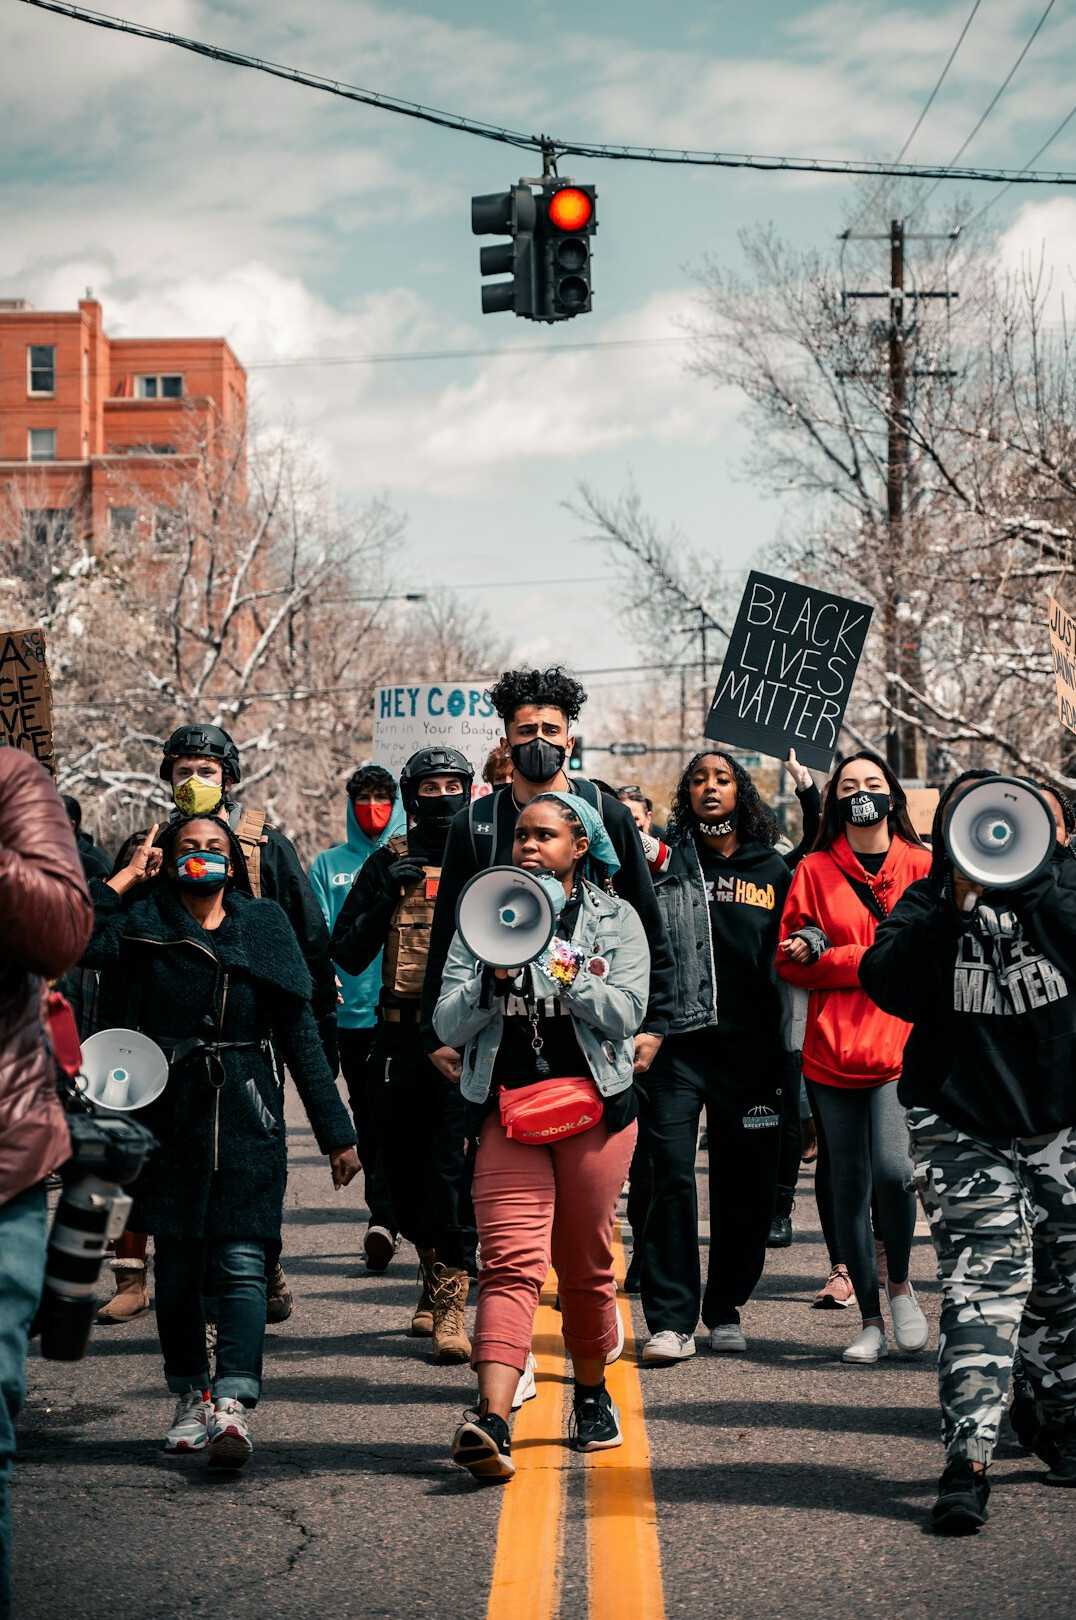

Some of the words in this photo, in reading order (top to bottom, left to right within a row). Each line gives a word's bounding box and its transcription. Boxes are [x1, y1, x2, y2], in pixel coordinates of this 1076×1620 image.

[747, 583, 865, 659] BLACK
[740, 632, 847, 696] LIVES
[0, 674, 41, 707] GE
[380, 688, 419, 718] HEY
[427, 687, 495, 717] COPS
[712, 671, 841, 748] MATTER
[375, 721, 397, 734] Turn
[402, 720, 413, 734] in
[423, 721, 453, 734] Your
[374, 740, 406, 751] Throw
[852, 811, 879, 823] MATTER
[854, 804, 873, 816] LIVES
[716, 890, 734, 902] THE
[735, 878, 775, 911] HOOD
[954, 958, 1069, 1016] MATER
